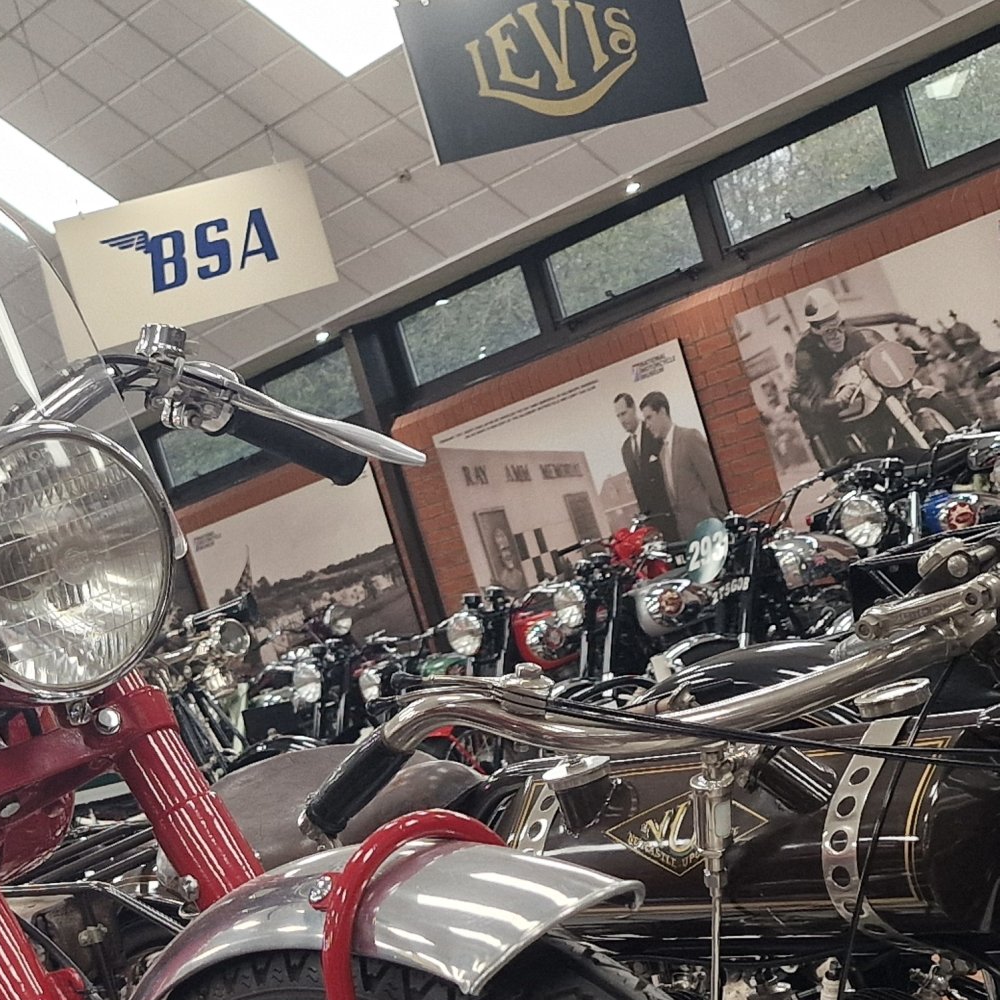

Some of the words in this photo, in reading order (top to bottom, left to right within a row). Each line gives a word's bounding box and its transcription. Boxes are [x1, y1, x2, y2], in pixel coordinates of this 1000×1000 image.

[465, 0, 637, 108] LEVIS
[149, 208, 280, 294] BSA
[462, 465, 489, 486] RAY
[681, 849, 703, 867] UPO
